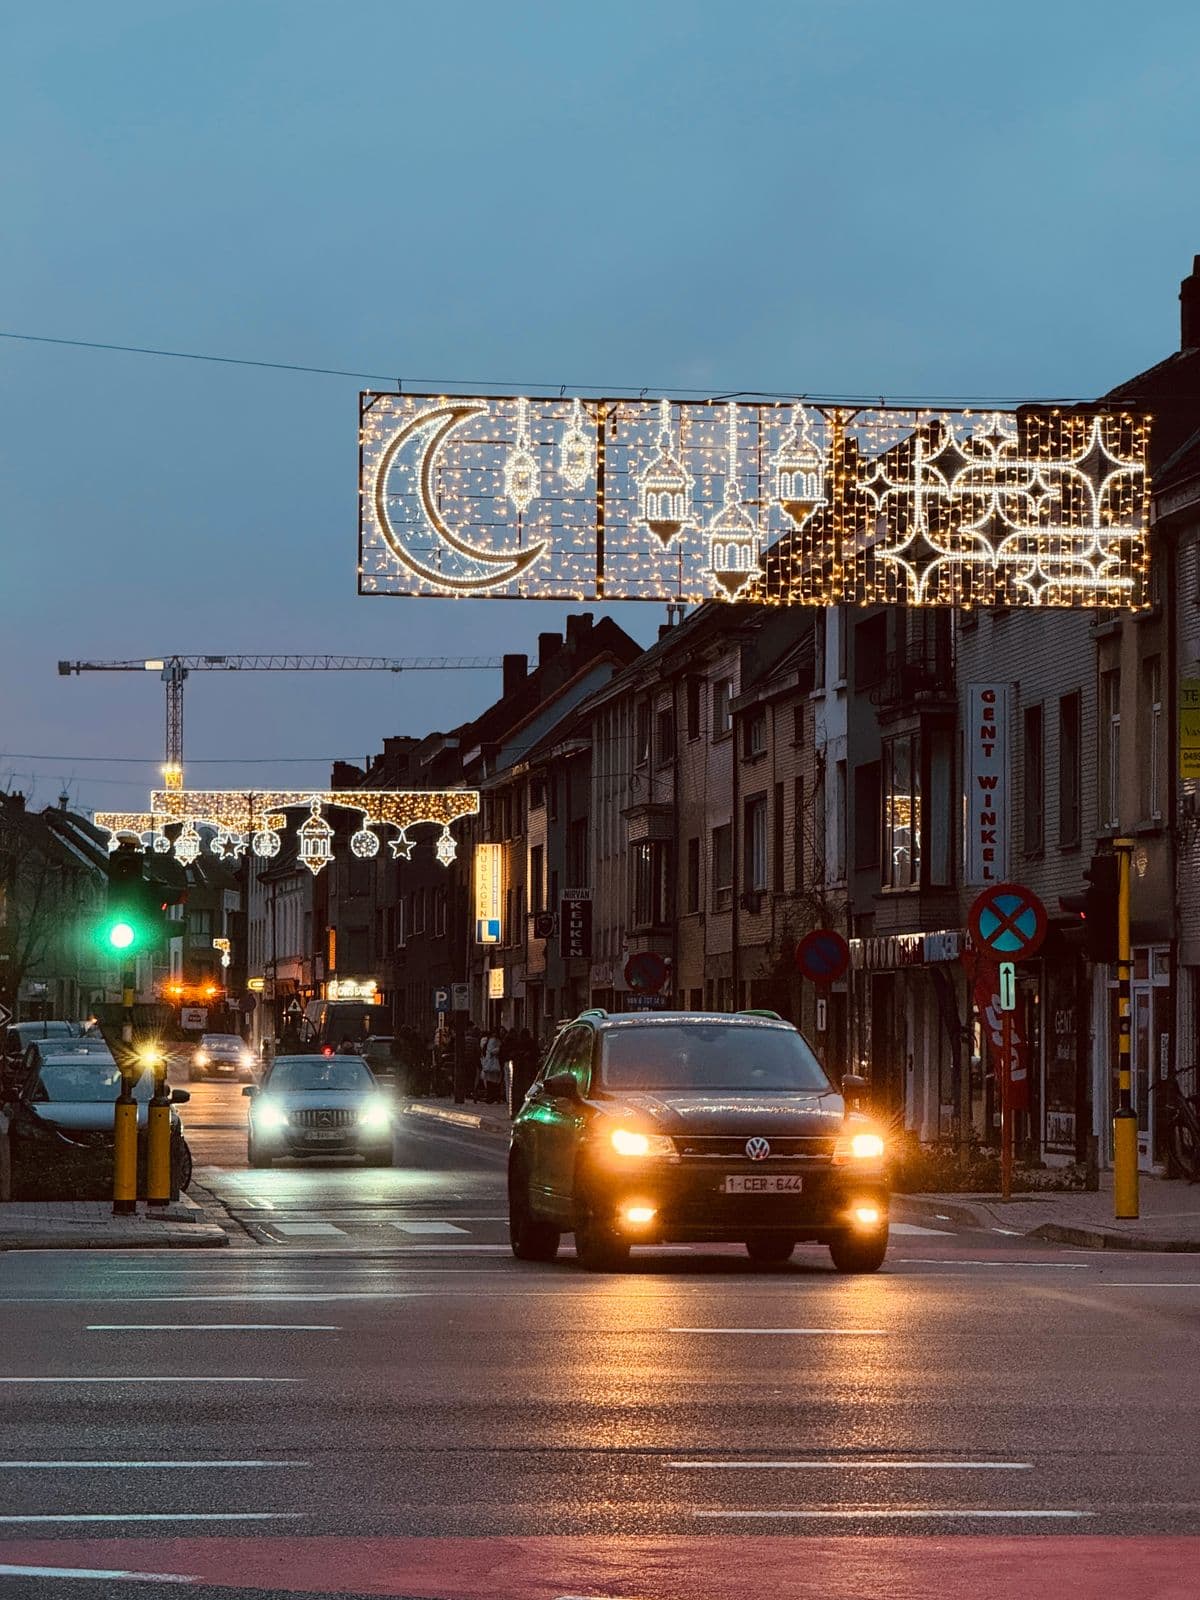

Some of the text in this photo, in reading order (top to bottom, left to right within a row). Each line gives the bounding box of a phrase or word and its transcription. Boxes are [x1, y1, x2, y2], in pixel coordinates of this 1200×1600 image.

[977, 689, 998, 880] GENT WINKEL
[569, 902, 583, 956] KEUKEN
[435, 991, 448, 1009] P
[728, 1178, 801, 1191] 1-CER-644
